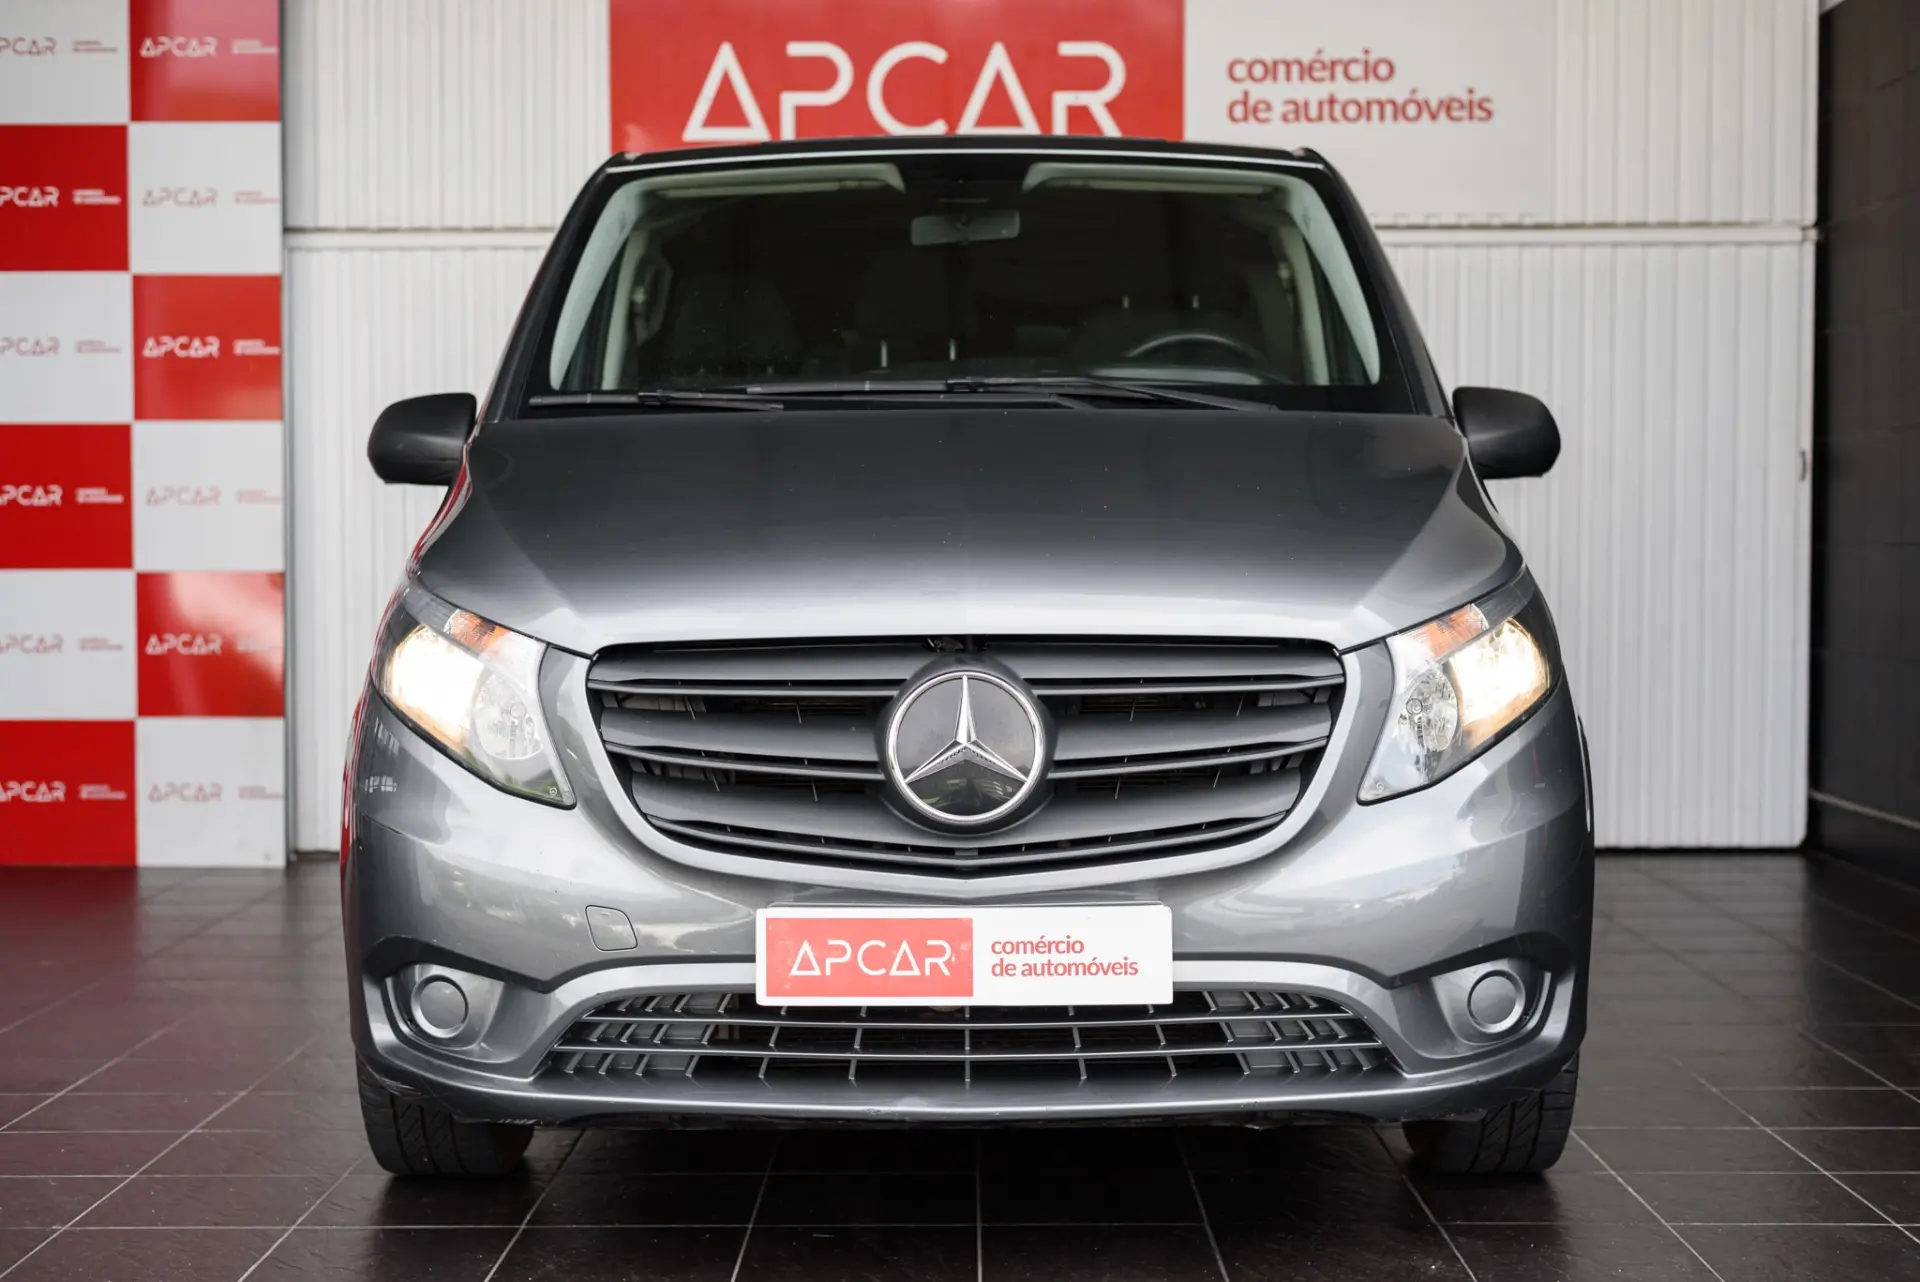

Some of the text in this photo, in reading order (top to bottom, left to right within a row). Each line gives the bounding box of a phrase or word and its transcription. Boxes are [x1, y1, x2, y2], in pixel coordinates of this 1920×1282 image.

[0, 37, 57, 56] PCAR
[140, 36, 218, 57] APCAR
[1227, 48, 1396, 83] comércio
[682, 41, 1127, 142] APCAR
[1227, 87, 1494, 123] de automóveis
[0, 186, 60, 207] PCAR
[143, 187, 218, 206] APCAR
[0, 336, 60, 356] PCAR
[142, 336, 220, 358] APCAR
[0, 484, 63, 506] PCAR
[145, 486, 222, 506] APCAR
[0, 634, 64, 654] PCAR
[145, 633, 222, 655] APCAR
[149, 782, 222, 802] APCAR
[990, 935, 1085, 955] comércio
[788, 939, 952, 976] APCAR
[991, 956, 1139, 977] de automóveis
